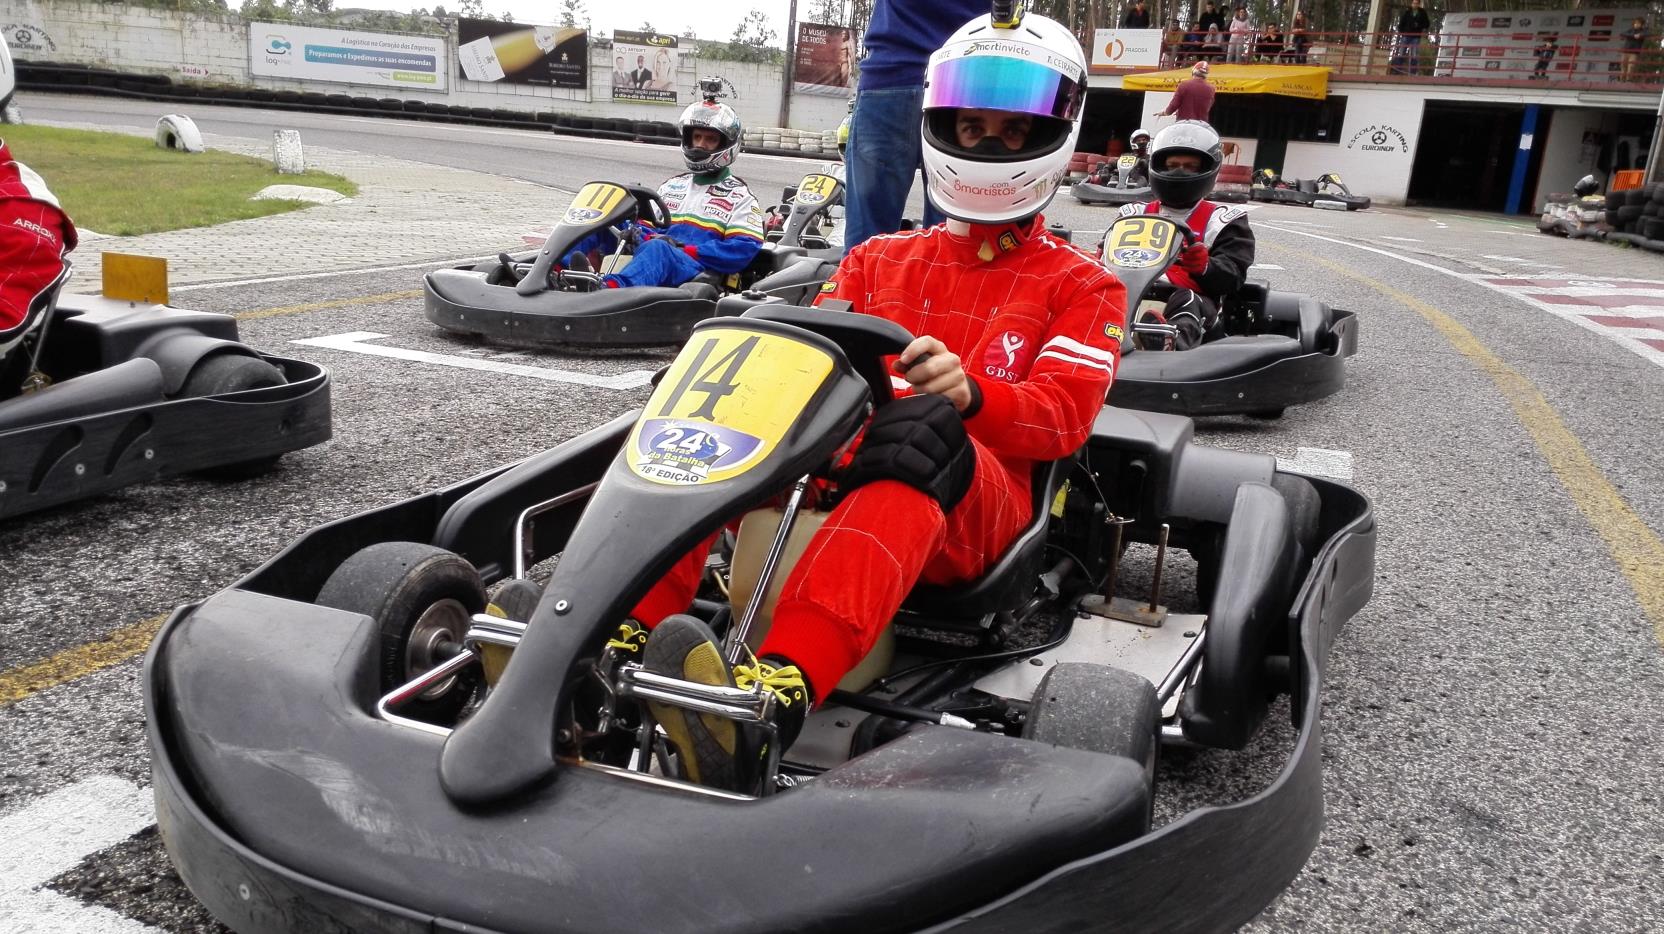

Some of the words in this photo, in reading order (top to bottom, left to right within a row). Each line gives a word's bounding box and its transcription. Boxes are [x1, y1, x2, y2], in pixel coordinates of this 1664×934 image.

[1347, 125, 1376, 149] ESCOLA
[1381, 124, 1409, 153] KARTING
[1121, 155, 1136, 164] 22
[586, 185, 617, 210] 11
[801, 175, 828, 195] 24
[1118, 219, 1170, 249] 29
[657, 335, 761, 421] 14
[656, 428, 706, 453] 24
[656, 469, 700, 484] EDIÇÃO
